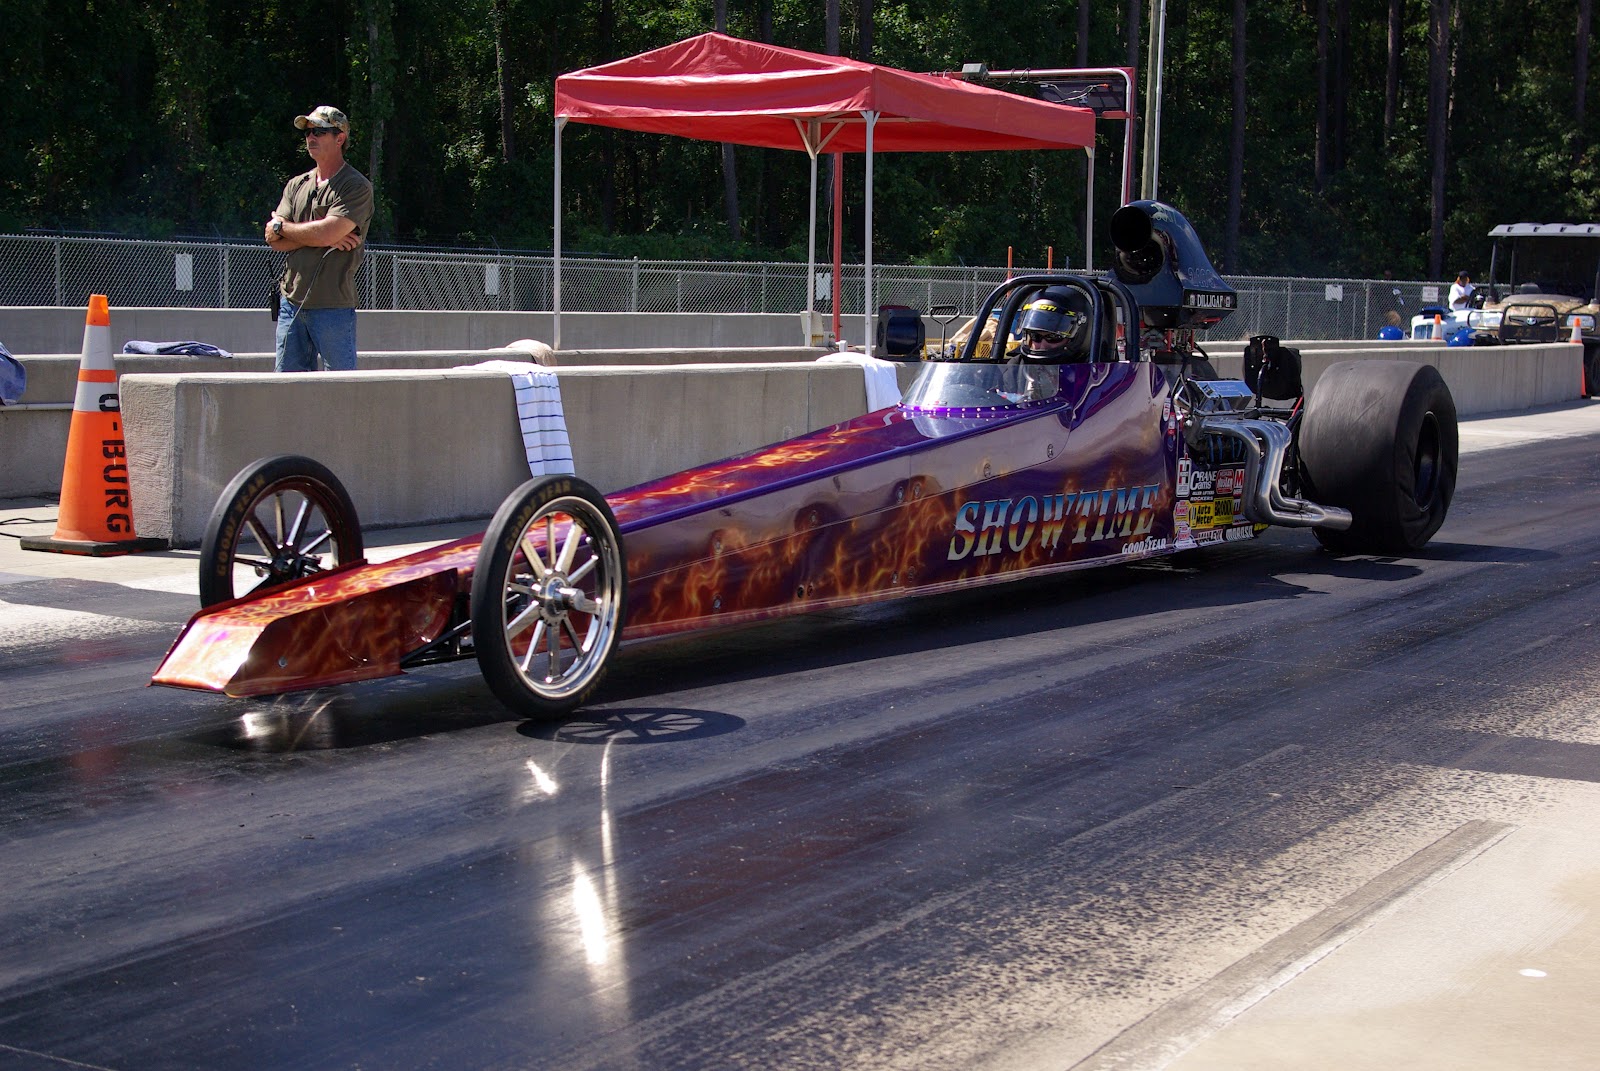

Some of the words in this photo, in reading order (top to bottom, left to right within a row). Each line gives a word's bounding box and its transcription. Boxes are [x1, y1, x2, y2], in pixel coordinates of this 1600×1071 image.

[99, 393, 131, 533] O-BURG
[947, 483, 1160, 560] SHOWTIME
[1196, 515, 1213, 525] Meter
[1198, 505, 1211, 514] Auto
